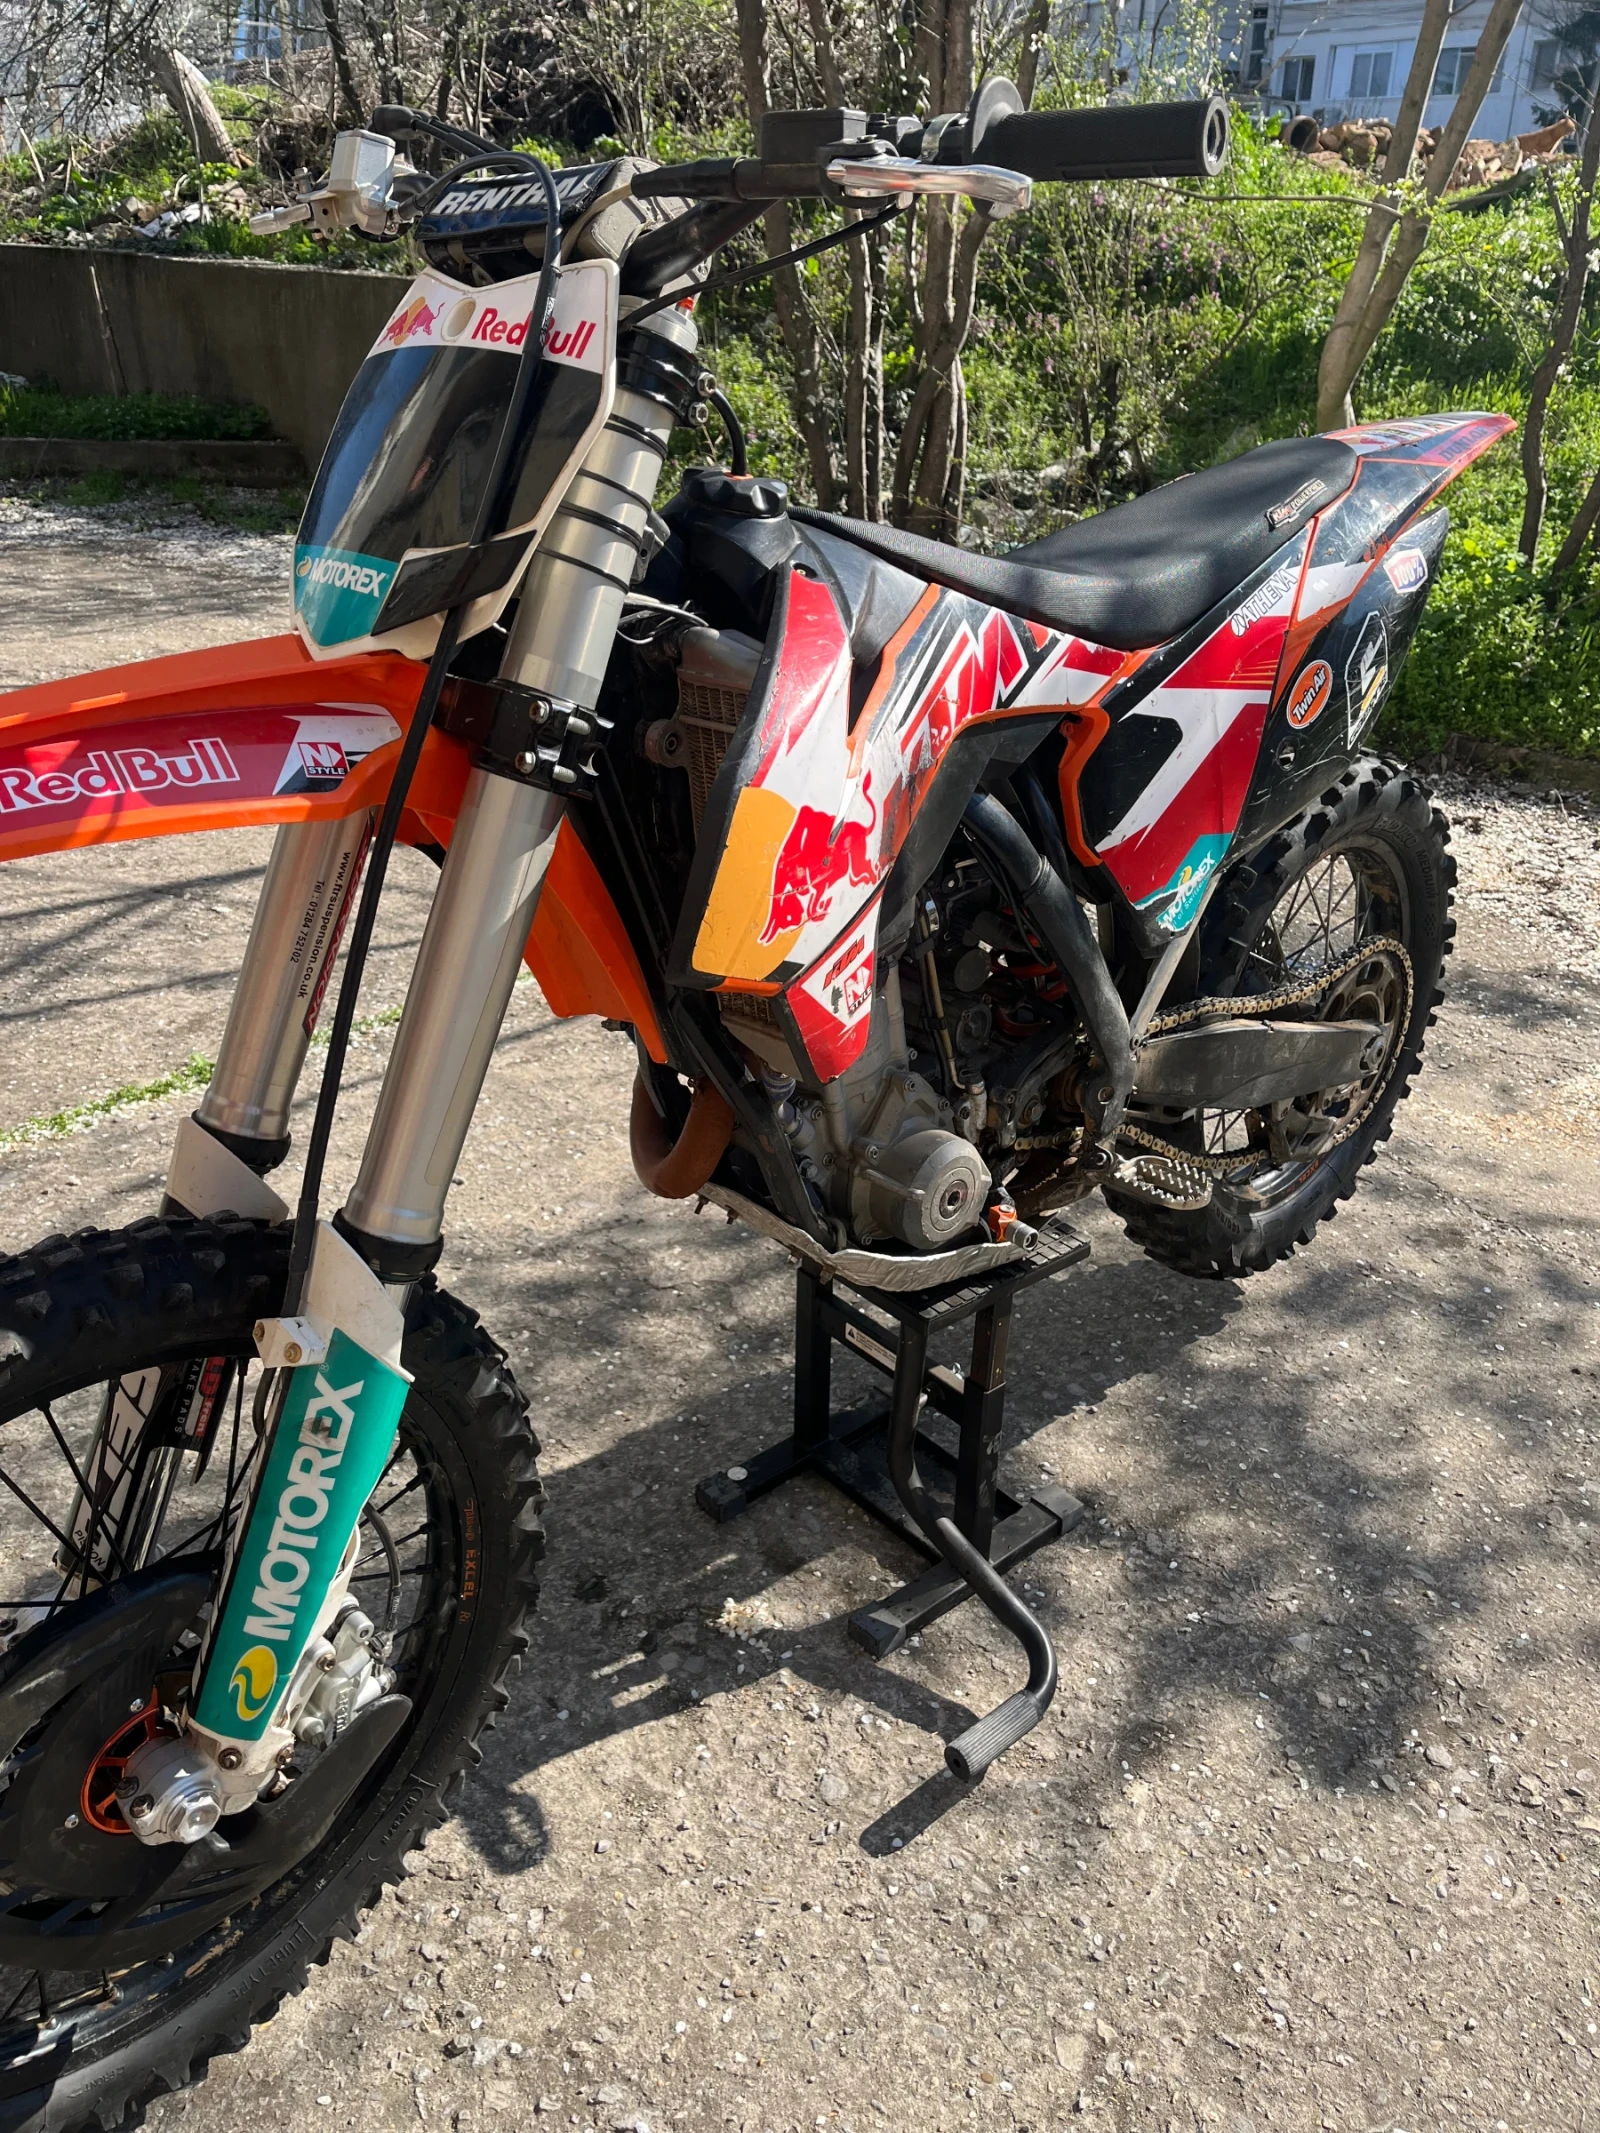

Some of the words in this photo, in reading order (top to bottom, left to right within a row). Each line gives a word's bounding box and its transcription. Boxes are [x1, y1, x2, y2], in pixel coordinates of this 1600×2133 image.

[471, 307, 533, 346] Red
[1439, 426, 1489, 461] DUNLOP
[308, 557, 386, 598] MOTOREX
[1393, 560, 1425, 586] 100%
[1243, 567, 1298, 629] ATHENA
[1291, 687, 1316, 723] Twin
[1314, 665, 1328, 694] Air
[0, 750, 125, 813] Red
[113, 737, 240, 793] Bull
[307, 765, 346, 776] STYLE
[1415, 849, 1438, 899] MEDIUM
[297, 851, 351, 998] www.ftrsuspension.co.uk
[303, 901, 319, 929] 01284
[290, 929, 307, 964] 752102
[822, 934, 866, 991] KTM
[174, 1398, 193, 1434] PADS
[243, 1370, 365, 1642] MOTOREX
